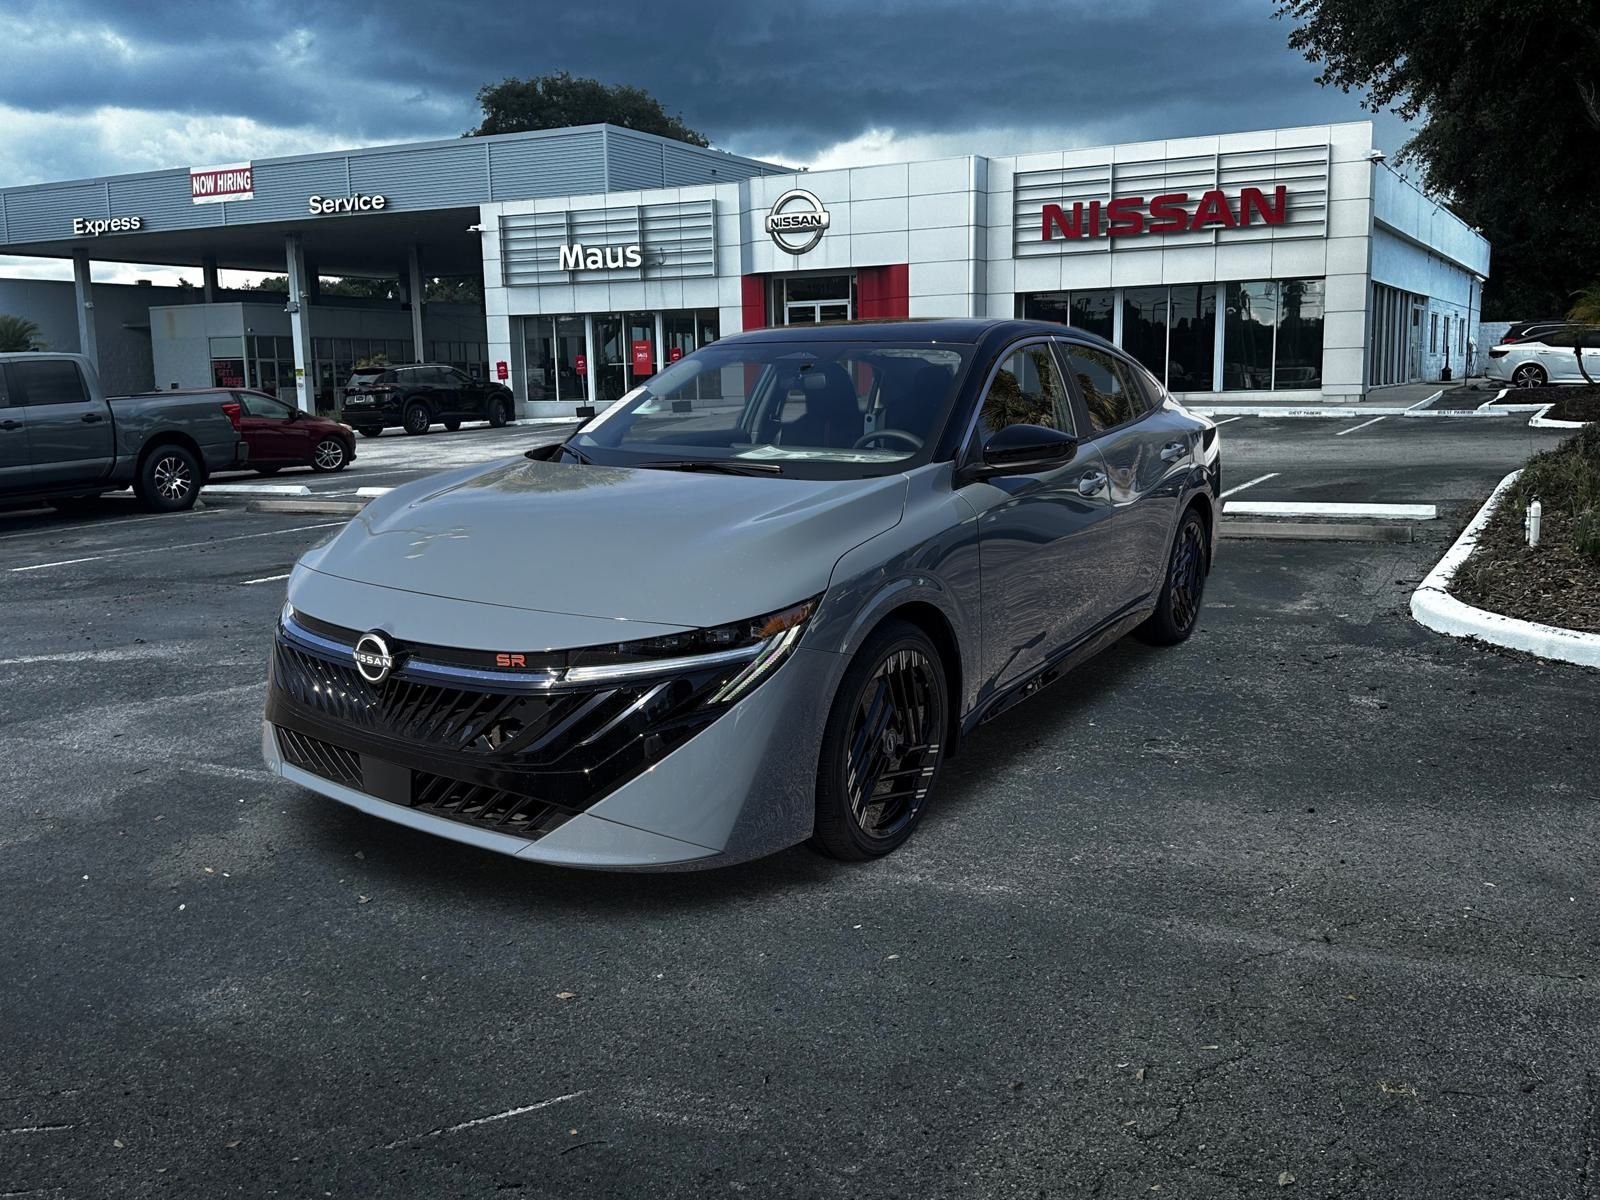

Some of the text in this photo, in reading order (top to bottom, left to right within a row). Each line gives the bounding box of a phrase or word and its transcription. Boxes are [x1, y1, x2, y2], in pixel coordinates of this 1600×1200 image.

[192, 171, 251, 194] NOW HIRING
[308, 193, 385, 215] Service
[1042, 185, 1287, 240] NISSAN
[73, 215, 141, 236] Express
[770, 214, 822, 229] NISSAN
[559, 243, 642, 270] Maus
[352, 651, 391, 667] NISSAN
[496, 654, 526, 667] SR
